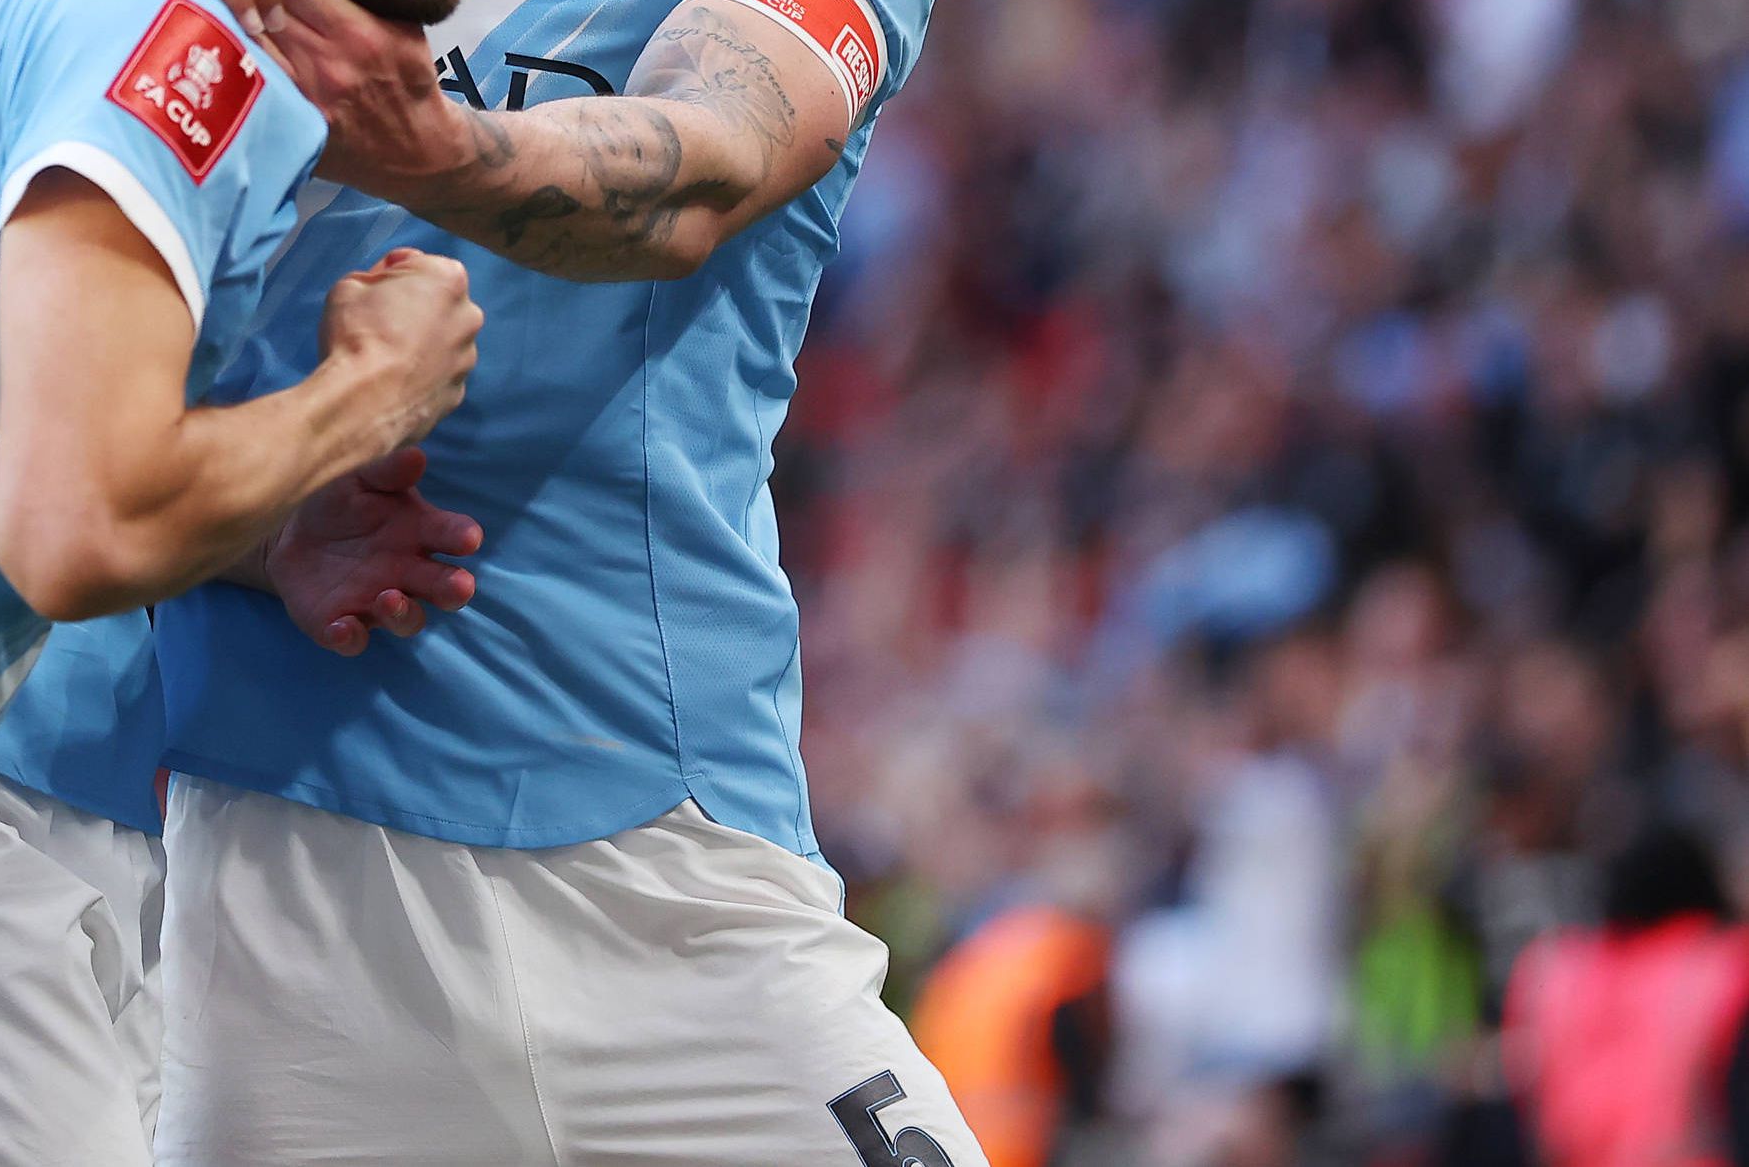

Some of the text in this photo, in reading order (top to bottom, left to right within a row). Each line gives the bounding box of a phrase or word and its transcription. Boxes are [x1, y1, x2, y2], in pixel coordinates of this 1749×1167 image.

[133, 73, 212, 146] FA CUP
[826, 1069, 956, 1167] 5
